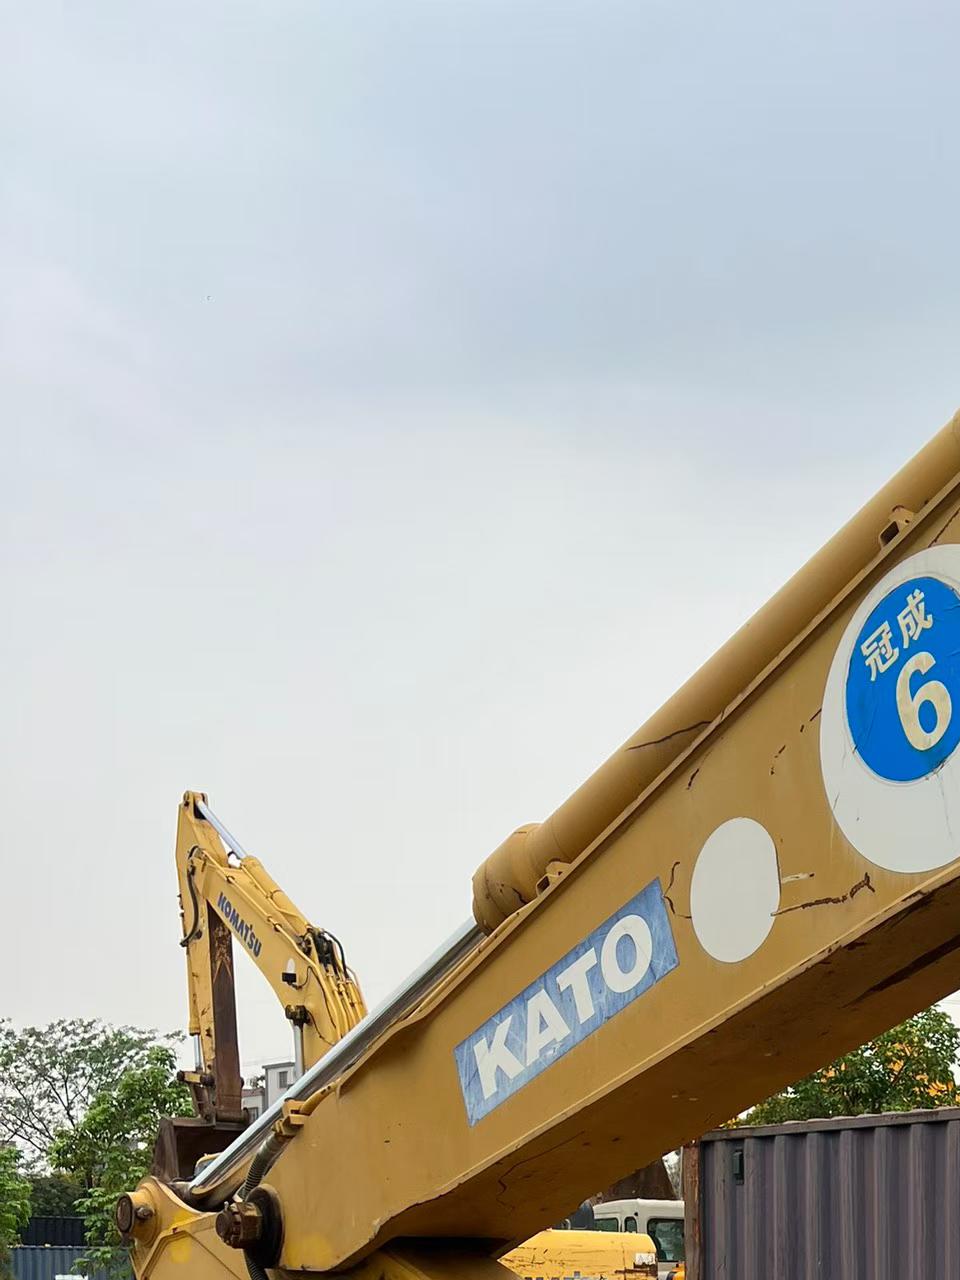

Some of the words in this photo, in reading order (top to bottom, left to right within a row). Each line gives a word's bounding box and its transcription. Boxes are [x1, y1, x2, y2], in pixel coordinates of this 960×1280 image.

[861, 588, 934, 681] 冠成
[896, 651, 953, 751] 6
[217, 892, 262, 958] KOMATSU
[473, 914, 653, 1100] KATO
